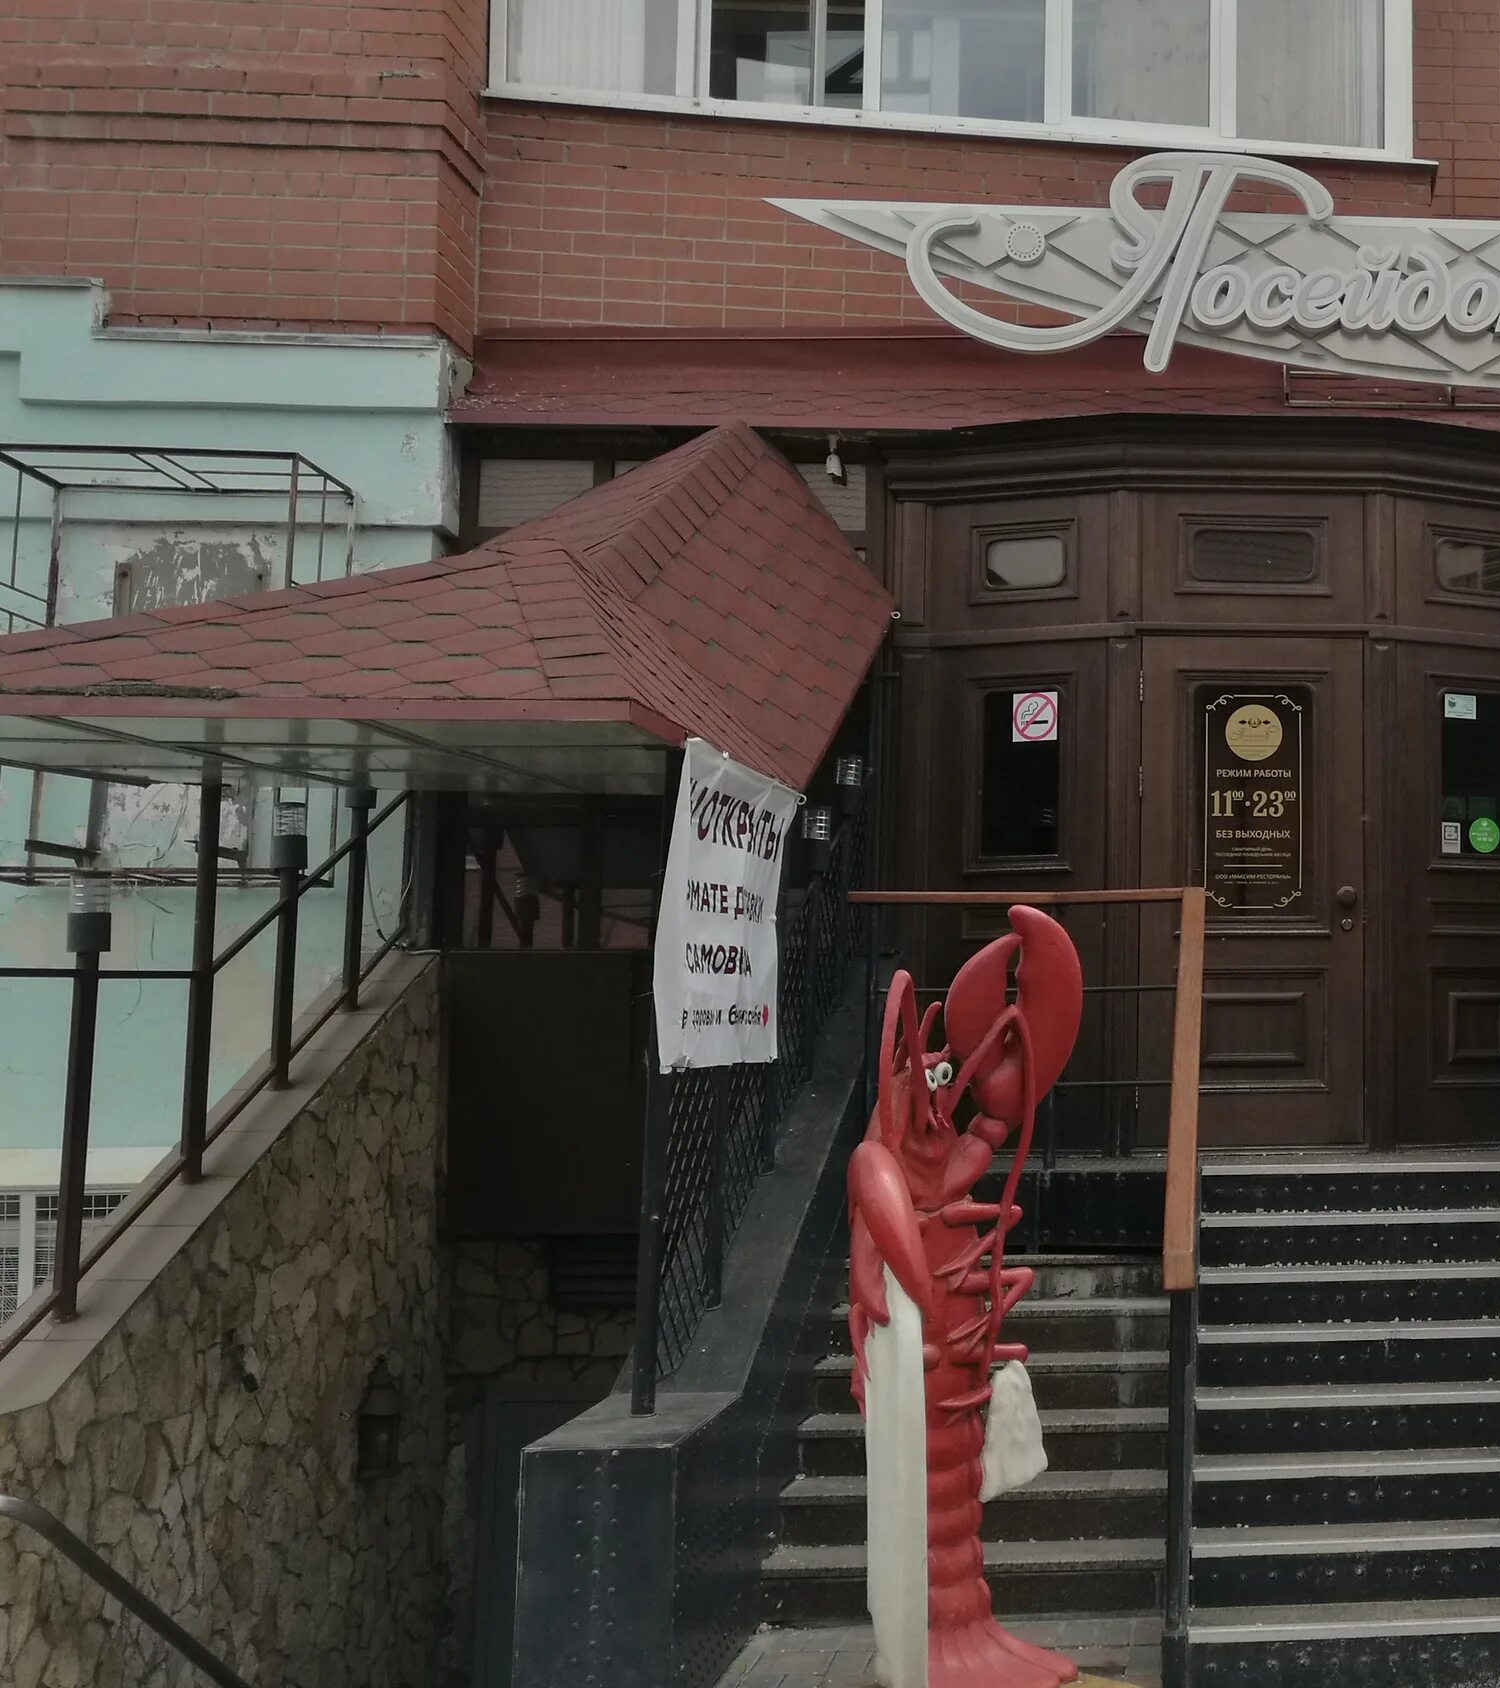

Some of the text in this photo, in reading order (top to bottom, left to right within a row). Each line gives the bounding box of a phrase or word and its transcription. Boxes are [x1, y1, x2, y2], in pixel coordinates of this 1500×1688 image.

[1216, 769, 1292, 778] РЕЖИМ РАБОТЫ
[1215, 829, 1291, 839] БЕЗ ВЫХОДНЫХ
